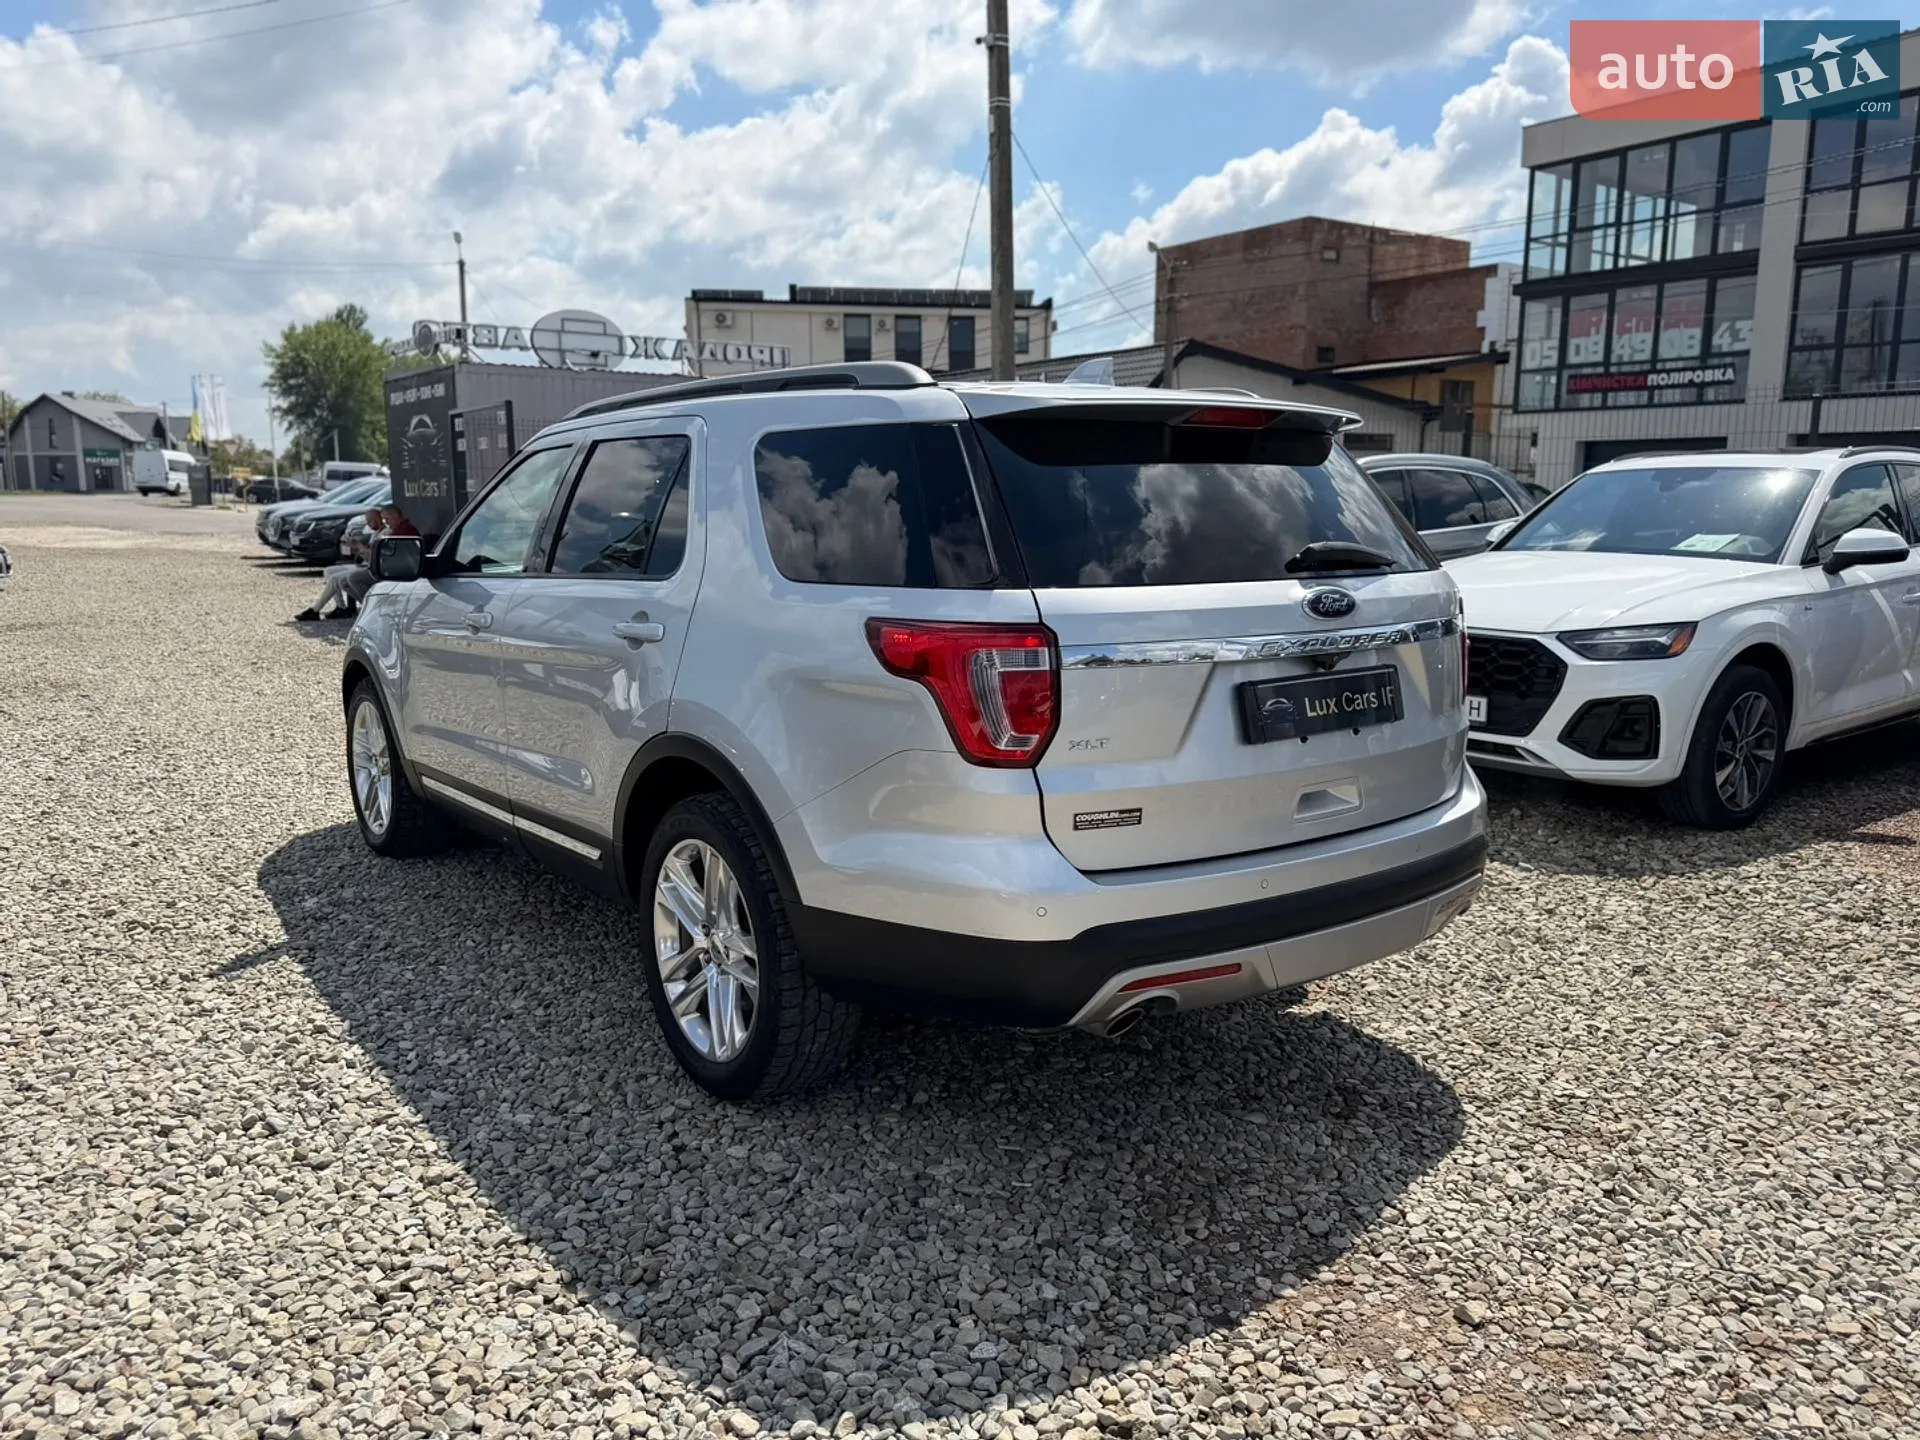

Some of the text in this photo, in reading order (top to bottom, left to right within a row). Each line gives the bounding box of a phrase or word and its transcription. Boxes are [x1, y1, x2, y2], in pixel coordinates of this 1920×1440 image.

[1647, 367, 1735, 386] ПОЛІРОВКА
[1319, 593, 1348, 612] Ford
[1260, 630, 1401, 656] EXPLORER
[1304, 686, 1395, 717] Lux Cars IF
[1069, 737, 1110, 751] XLT
